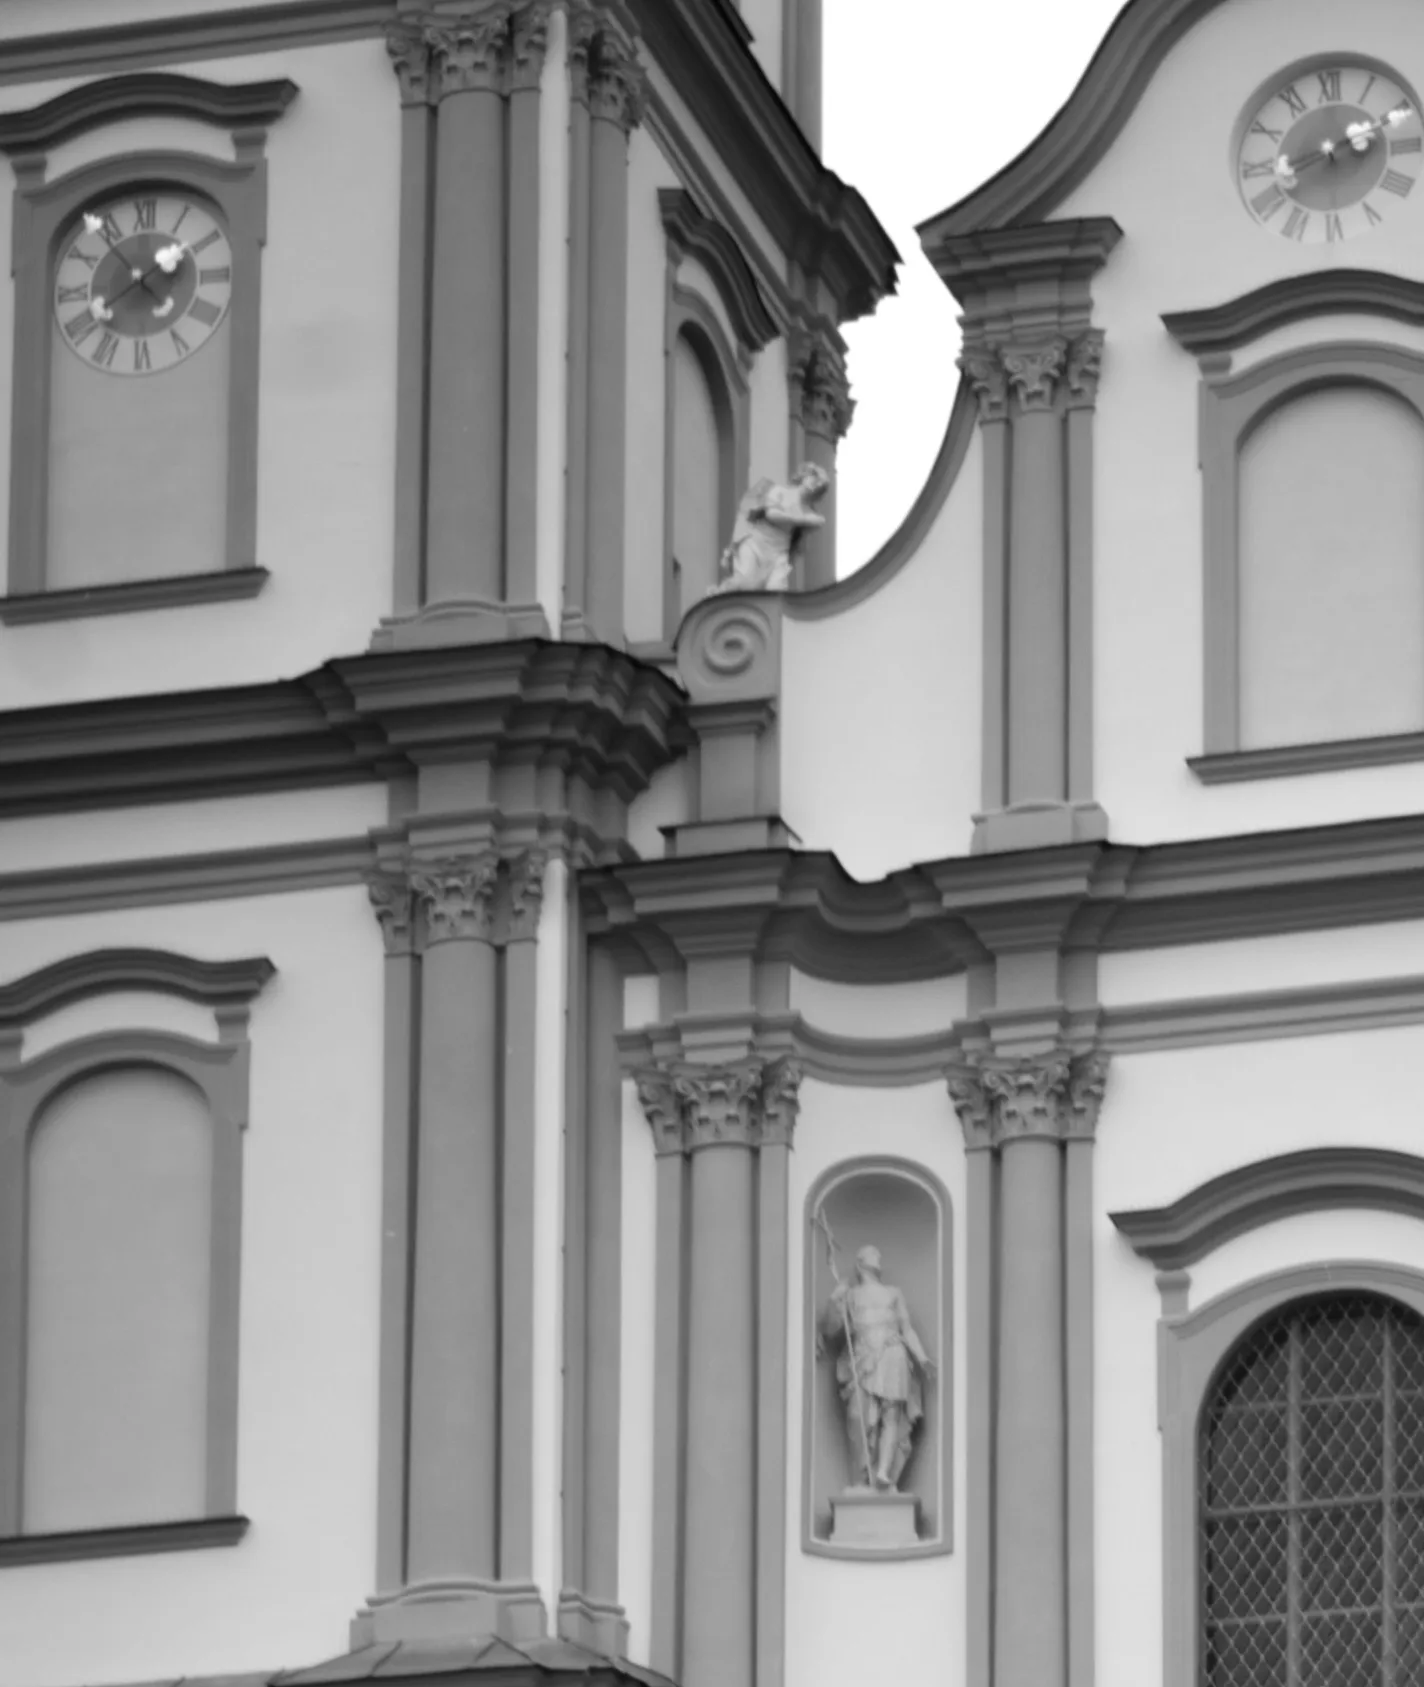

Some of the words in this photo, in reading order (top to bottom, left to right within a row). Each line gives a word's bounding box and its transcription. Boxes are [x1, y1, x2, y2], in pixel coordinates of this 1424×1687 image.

[1317, 71, 1342, 103] XII
[1278, 85, 1308, 119] XI
[1250, 121, 1282, 143] X
[1243, 157, 1275, 180] IX
[133, 199, 157, 232] XII
[1325, 213, 1343, 243] VI
[1362, 201, 1382, 226] V
[67, 245, 99, 270] X
[58, 284, 89, 305] IX
[134, 339, 151, 371] VI
[169, 328, 190, 357] V
